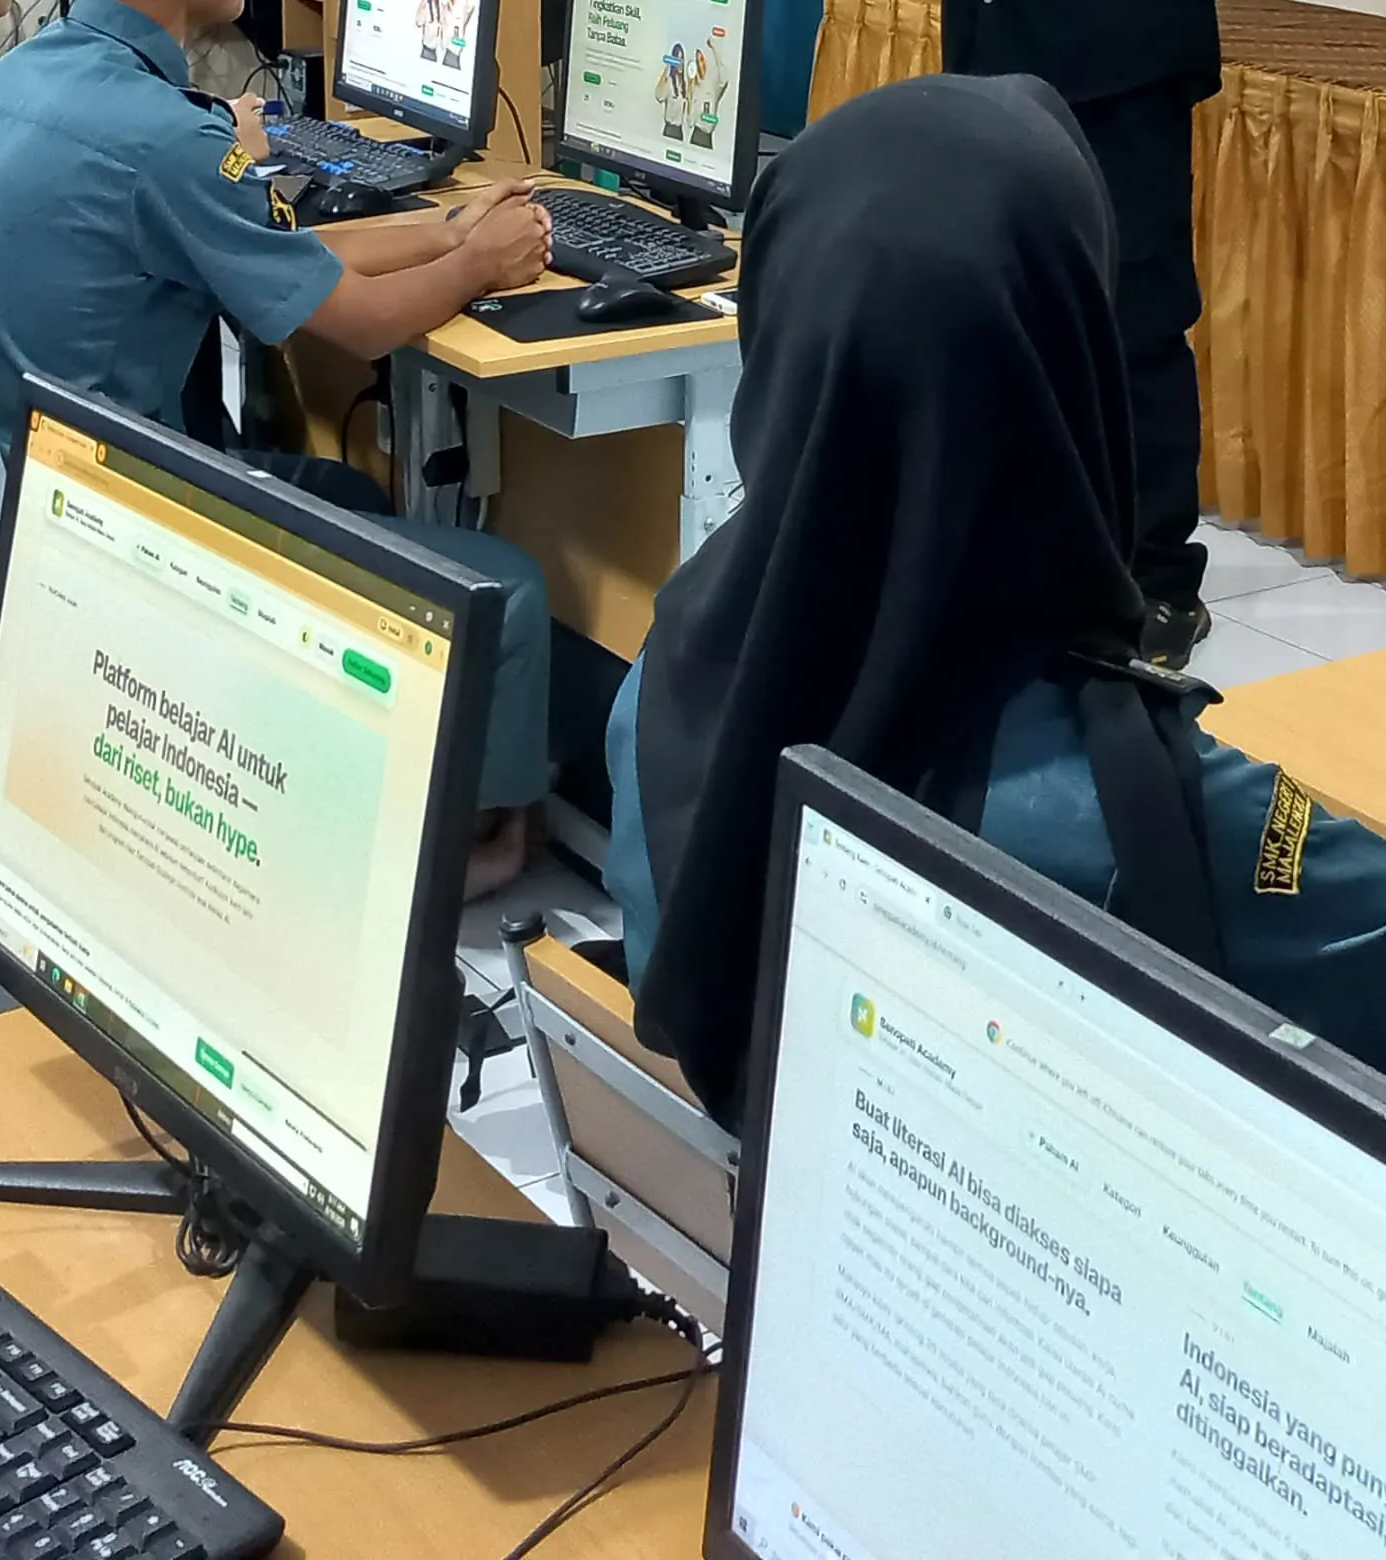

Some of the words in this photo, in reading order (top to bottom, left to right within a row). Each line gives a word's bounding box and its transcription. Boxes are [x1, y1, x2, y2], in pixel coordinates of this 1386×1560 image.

[92, 647, 158, 714] Platform
[156, 688, 217, 755] belajar
[215, 724, 236, 762] AI
[235, 737, 289, 797] untuk
[105, 696, 161, 761] pelajar
[160, 731, 242, 809] Indonesia
[92, 728, 123, 773] dari
[122, 748, 165, 805] riset,
[164, 776, 215, 835] bukan
[214, 811, 264, 874] hype.
[1260, 838, 1281, 885] SMK
[879, 1014, 916, 1055] Senopati
[916, 1040, 957, 1085] Academy
[850, 1116, 888, 1165] saja,
[889, 1146, 948, 1210] apapun
[948, 1188, 1093, 1322] background-nya.
[853, 1086, 891, 1133] Buat
[892, 1114, 946, 1175] literasi
[947, 1155, 965, 1189] AI
[966, 1168, 1003, 1217] bisa
[1003, 1196, 1071, 1269] diakses
[1072, 1248, 1124, 1312] siapa
[1102, 1179, 1141, 1223] Kategori
[1162, 1222, 1221, 1279] Keunggulan
[1306, 1322, 1351, 1369] Majalah
[1178, 1363, 1205, 1408] AI,
[1207, 1386, 1251, 1445] siap
[1182, 1329, 1282, 1427] Indonesia
[1283, 1408, 1337, 1474] yang
[173, 1459, 205, 1485] AOC
[1175, 1394, 1310, 1522] ditinggalkan.
